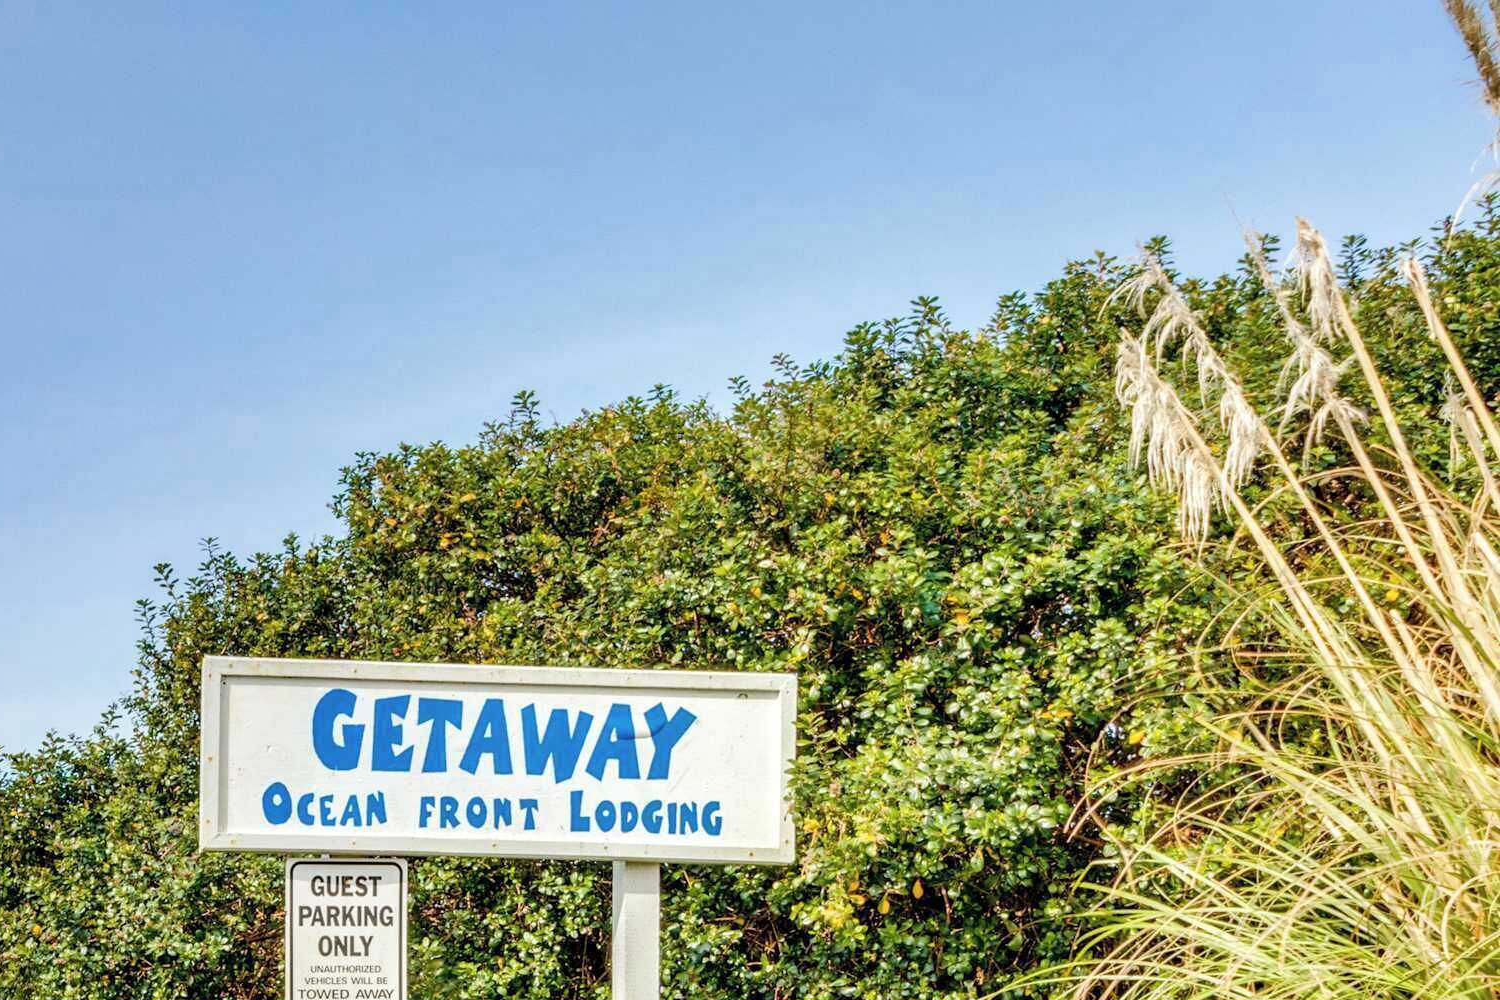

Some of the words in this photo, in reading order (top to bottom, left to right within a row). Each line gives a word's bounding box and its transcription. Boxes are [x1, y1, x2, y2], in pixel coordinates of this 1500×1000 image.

[312, 688, 697, 784] GETAWAY
[419, 794, 538, 831] FRONT
[310, 875, 382, 897] GUEST
[299, 905, 394, 927] PARKING
[318, 935, 374, 956] ONLY
[310, 965, 382, 974] UNAUTHORIZED
[304, 977, 348, 985] VEHICLES
[351, 977, 374, 985] WILL
[376, 977, 388, 985] BE
[298, 989, 350, 1000] TOWED
[355, 989, 394, 1000] AWAY
